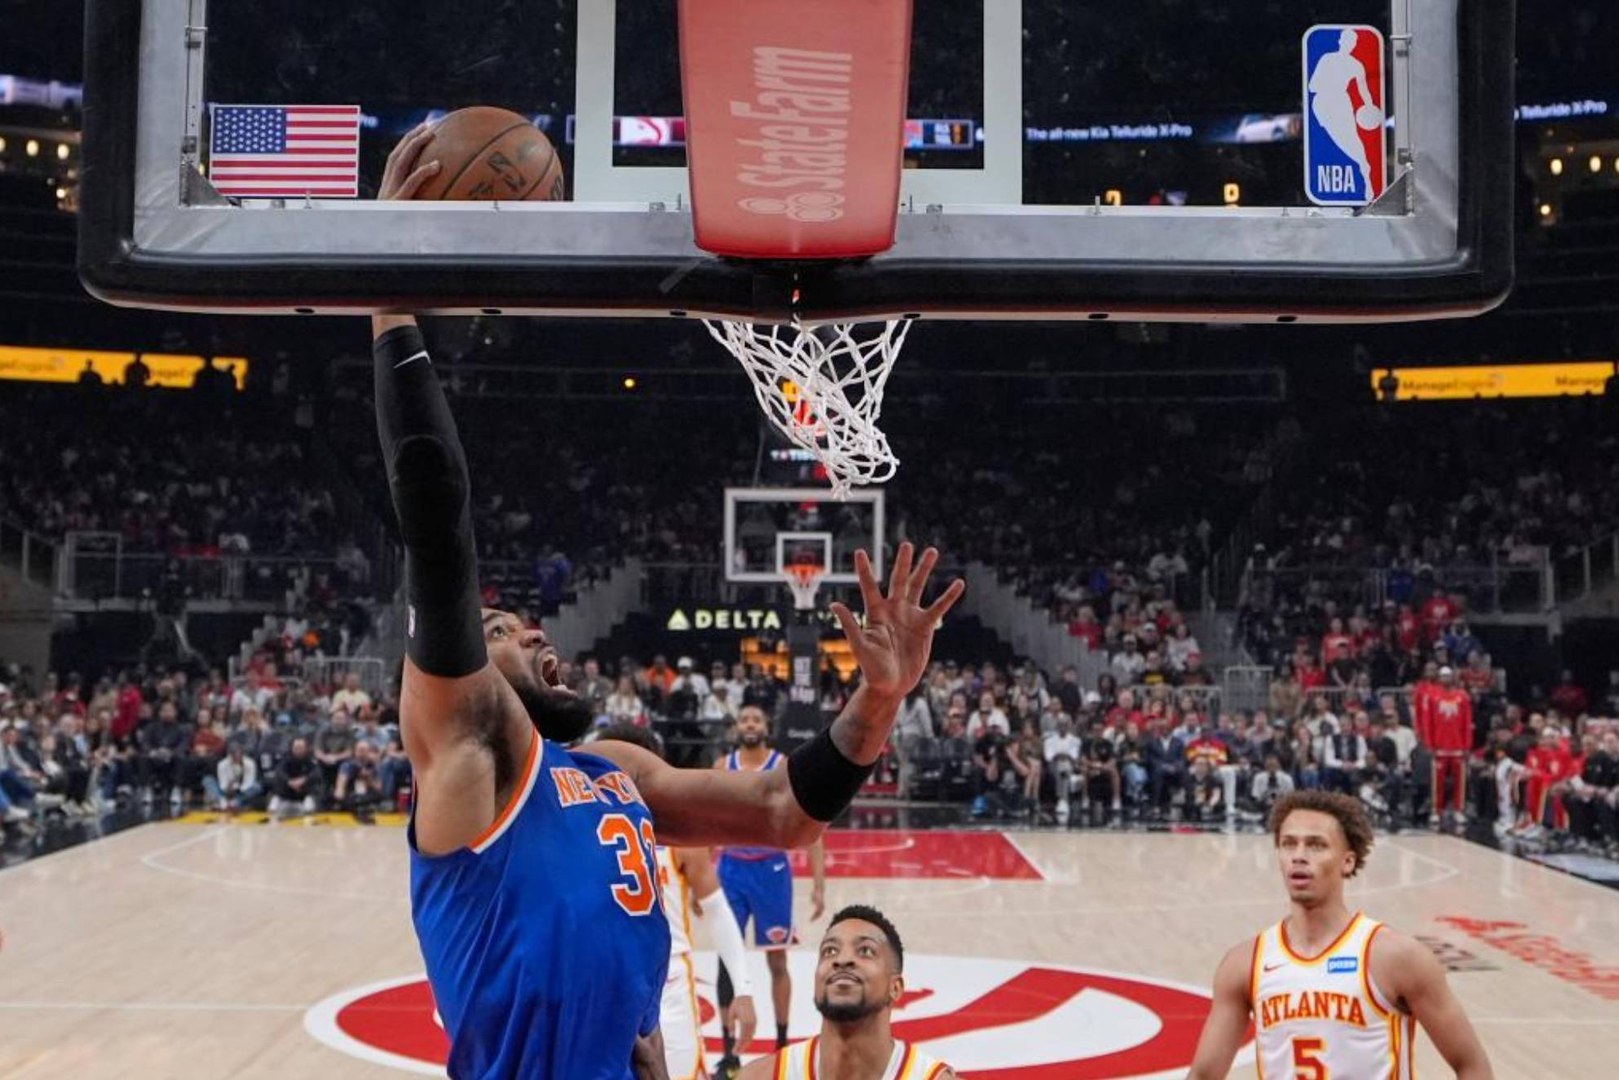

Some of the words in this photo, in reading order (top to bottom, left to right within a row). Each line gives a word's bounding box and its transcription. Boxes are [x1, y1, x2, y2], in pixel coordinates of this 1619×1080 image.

[1520, 104, 1571, 119] Telluride
[1571, 100, 1607, 114] X-Pro
[1026, 127, 1048, 140] The
[1048, 126, 1090, 140] all-new
[1090, 125, 1109, 139] Kia
[1110, 124, 1158, 139] Telluride
[1158, 122, 1193, 138] X-Pro
[1318, 164, 1356, 194] NBA
[695, 610, 781, 629] DELTA
[1261, 990, 1367, 1030] ATLANTA
[1291, 1036, 1328, 1080] 5
